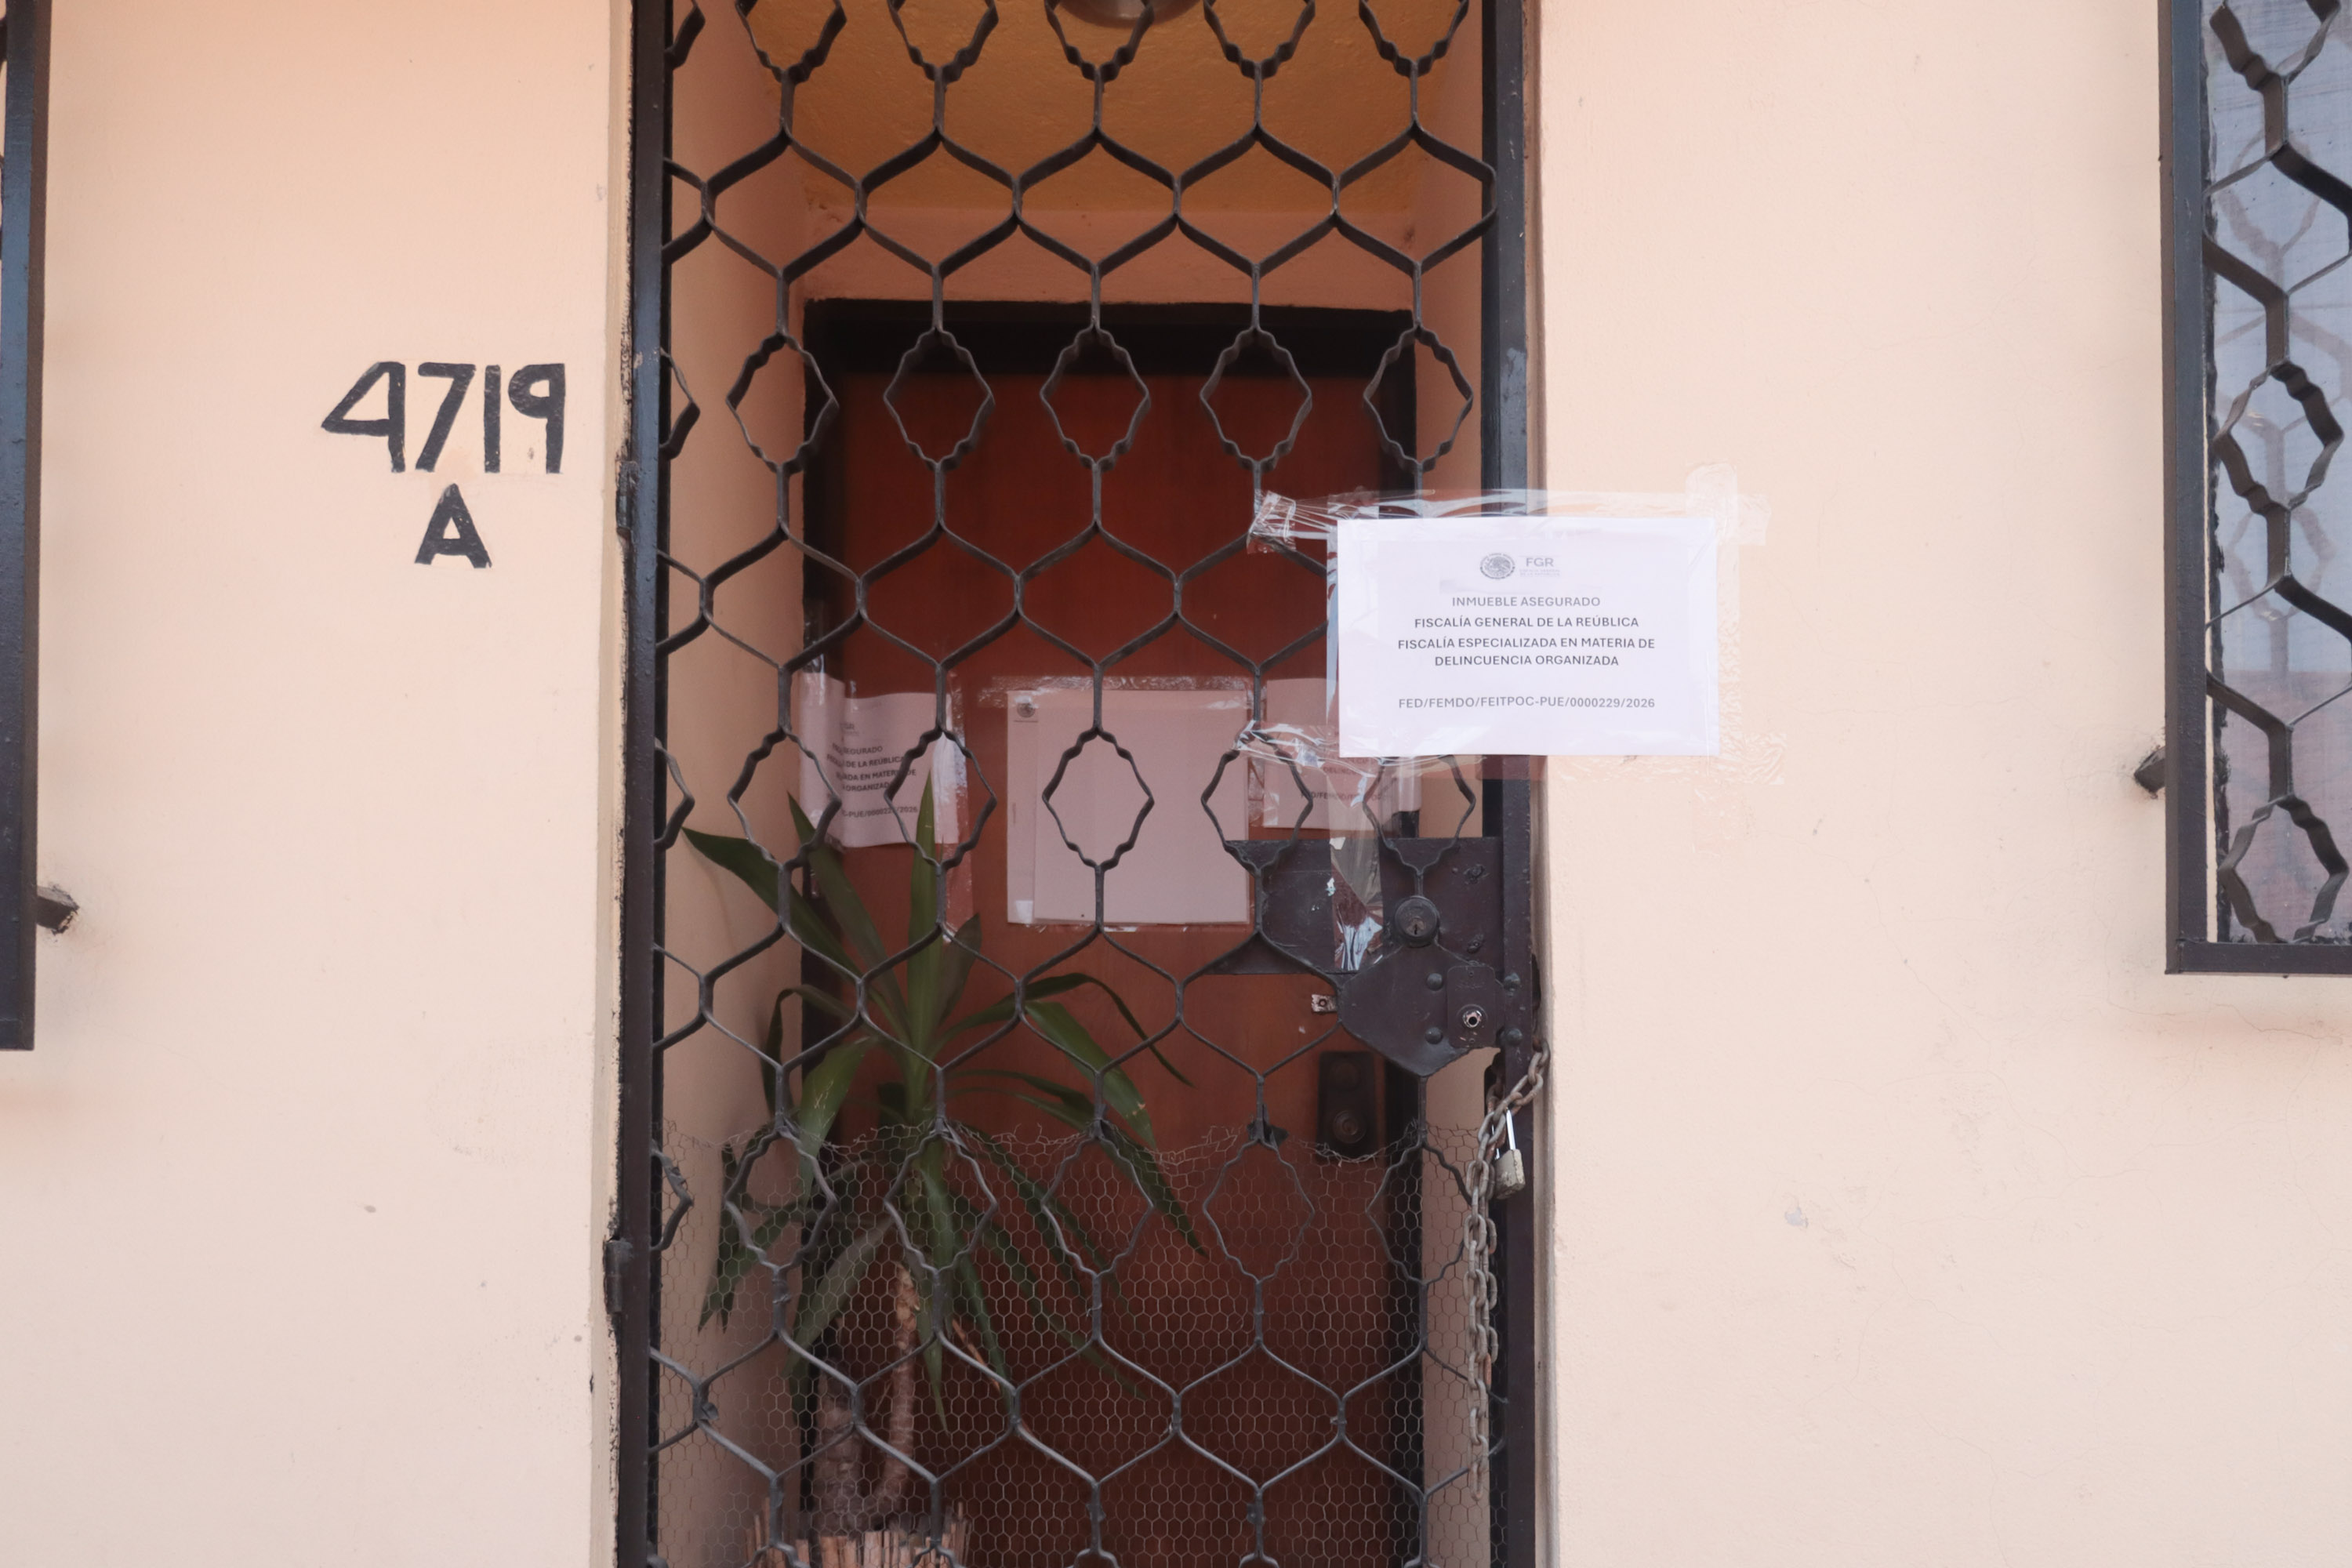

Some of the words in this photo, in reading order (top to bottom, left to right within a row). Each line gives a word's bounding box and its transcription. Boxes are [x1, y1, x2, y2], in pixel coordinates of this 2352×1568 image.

[321, 361, 566, 474] 4719
[414, 482, 492, 568] A
[1526, 557, 1554, 568] FGR
[1452, 597, 1517, 607] INMUEBLE
[1520, 597, 1600, 607] ASEGURADO
[1414, 615, 1471, 628] FISCALÍA
[1474, 617, 1534, 627] GENERAL
[1537, 617, 1554, 627] DE
[1557, 617, 1573, 627] LA
[1576, 614, 1639, 627] REÚBLICA
[1398, 636, 1454, 649] FISCALÍA
[1458, 637, 1557, 648] ESPECIALIZADA
[1560, 637, 1577, 648] EN
[1581, 637, 1635, 648] MATERIA
[1638, 638, 1655, 648] DE
[1435, 655, 1532, 666] DELINCUENCIA
[1535, 655, 1619, 666] ORGANIZADA
[1399, 696, 1655, 709] FED/FEMDO/FEITPOC-PUE/0000229/2026
